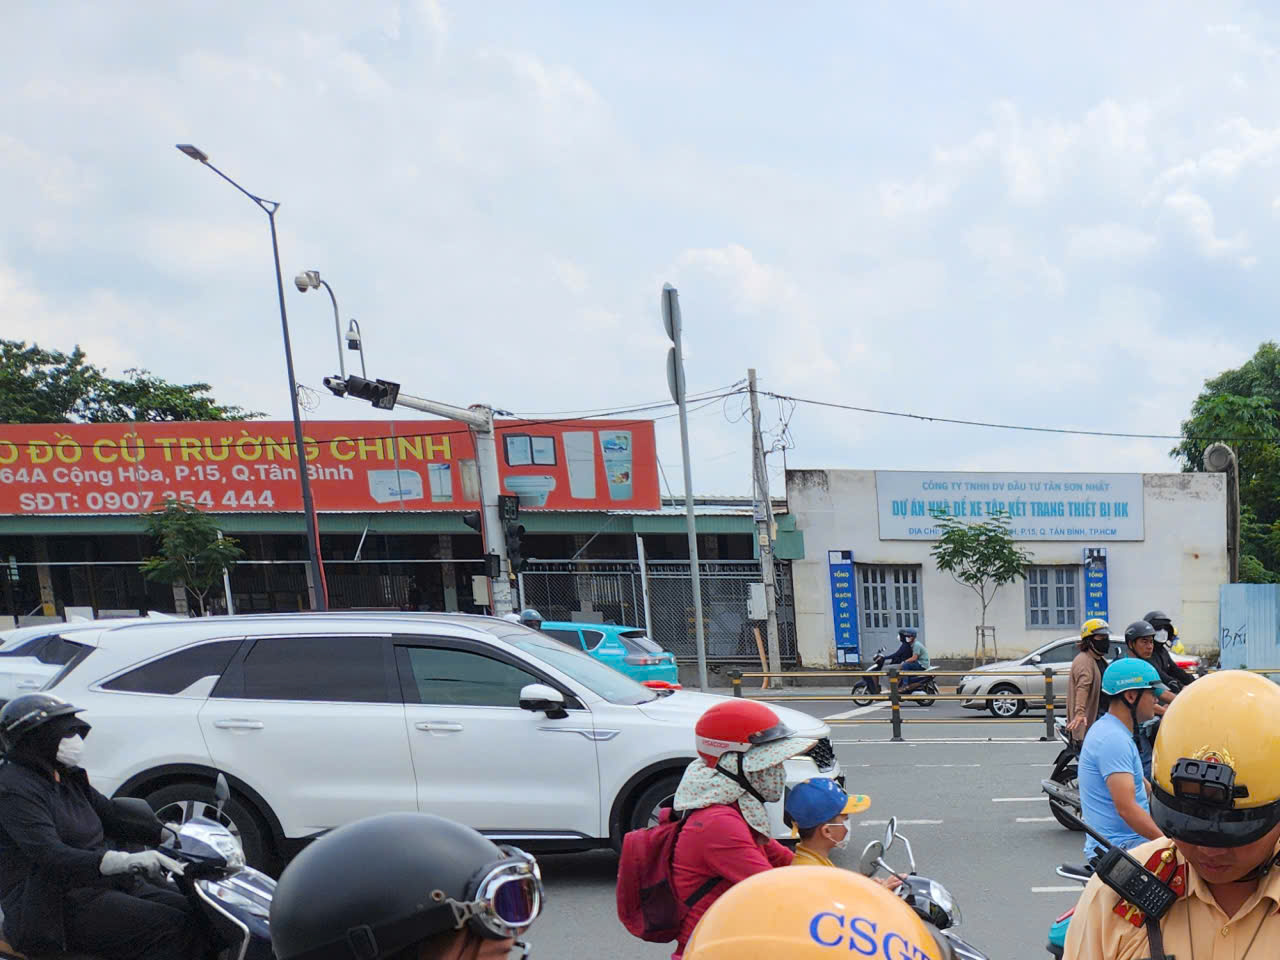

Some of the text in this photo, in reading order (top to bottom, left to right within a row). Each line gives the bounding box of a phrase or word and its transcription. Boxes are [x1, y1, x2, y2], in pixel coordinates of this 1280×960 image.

[26, 432, 83, 465] ĐỒ
[92, 432, 146, 464] CŨ
[154, 430, 320, 463] TRƯỜNG
[53, 466, 113, 487] Cộng
[118, 466, 170, 485] Hòa,
[175, 465, 227, 484] P.15,
[231, 463, 297, 482] Q.Tân
[19, 493, 79, 511] SĐT:
[86, 491, 154, 511] 0907
[221, 489, 275, 508] 444
[970, 501, 983, 517] XE
[1030, 501, 1064, 517] TRANG
[1089, 527, 1117, 537] TP.HCM
